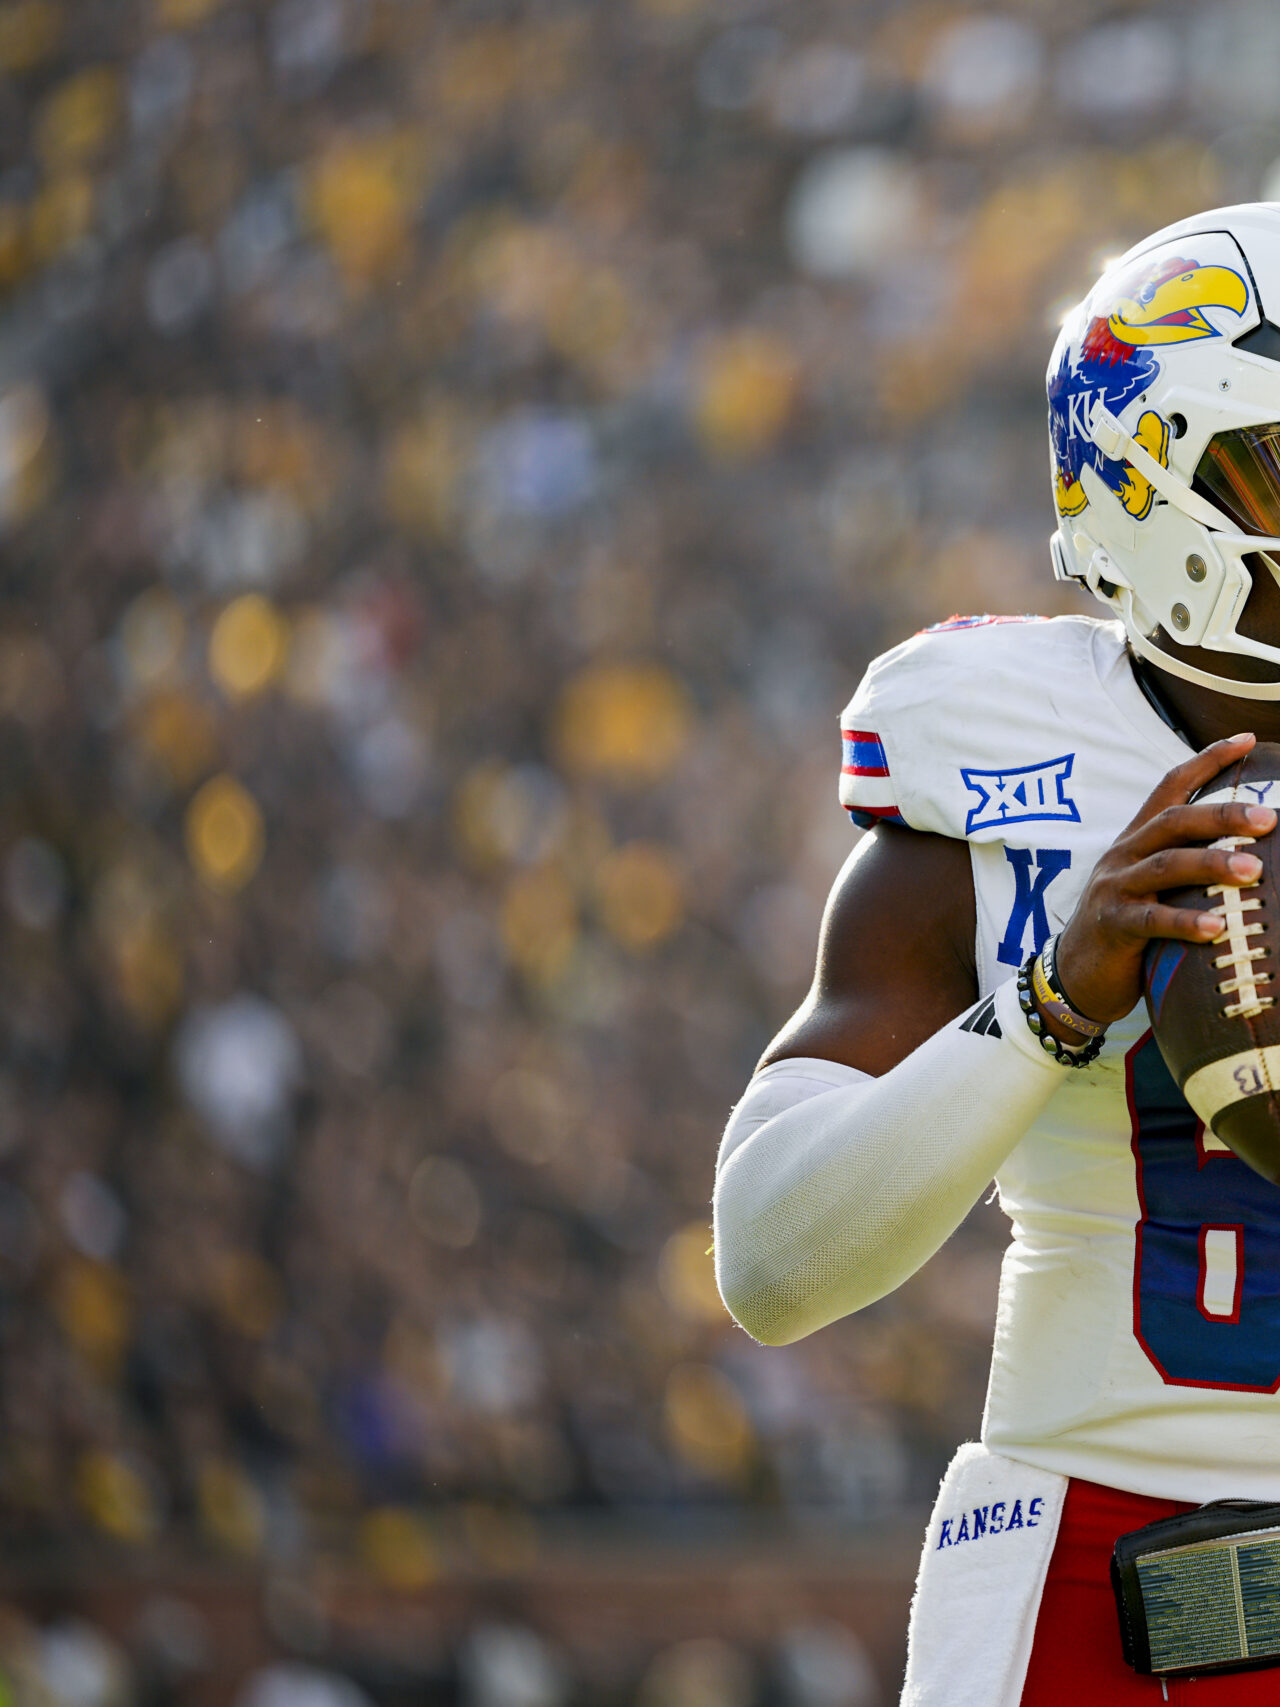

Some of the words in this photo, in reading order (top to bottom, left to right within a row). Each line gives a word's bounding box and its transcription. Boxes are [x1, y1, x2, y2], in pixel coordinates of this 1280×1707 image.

[1067, 386, 1108, 443] KU
[961, 754, 1079, 834] XII
[936, 1497, 1045, 1551] KANSAS
